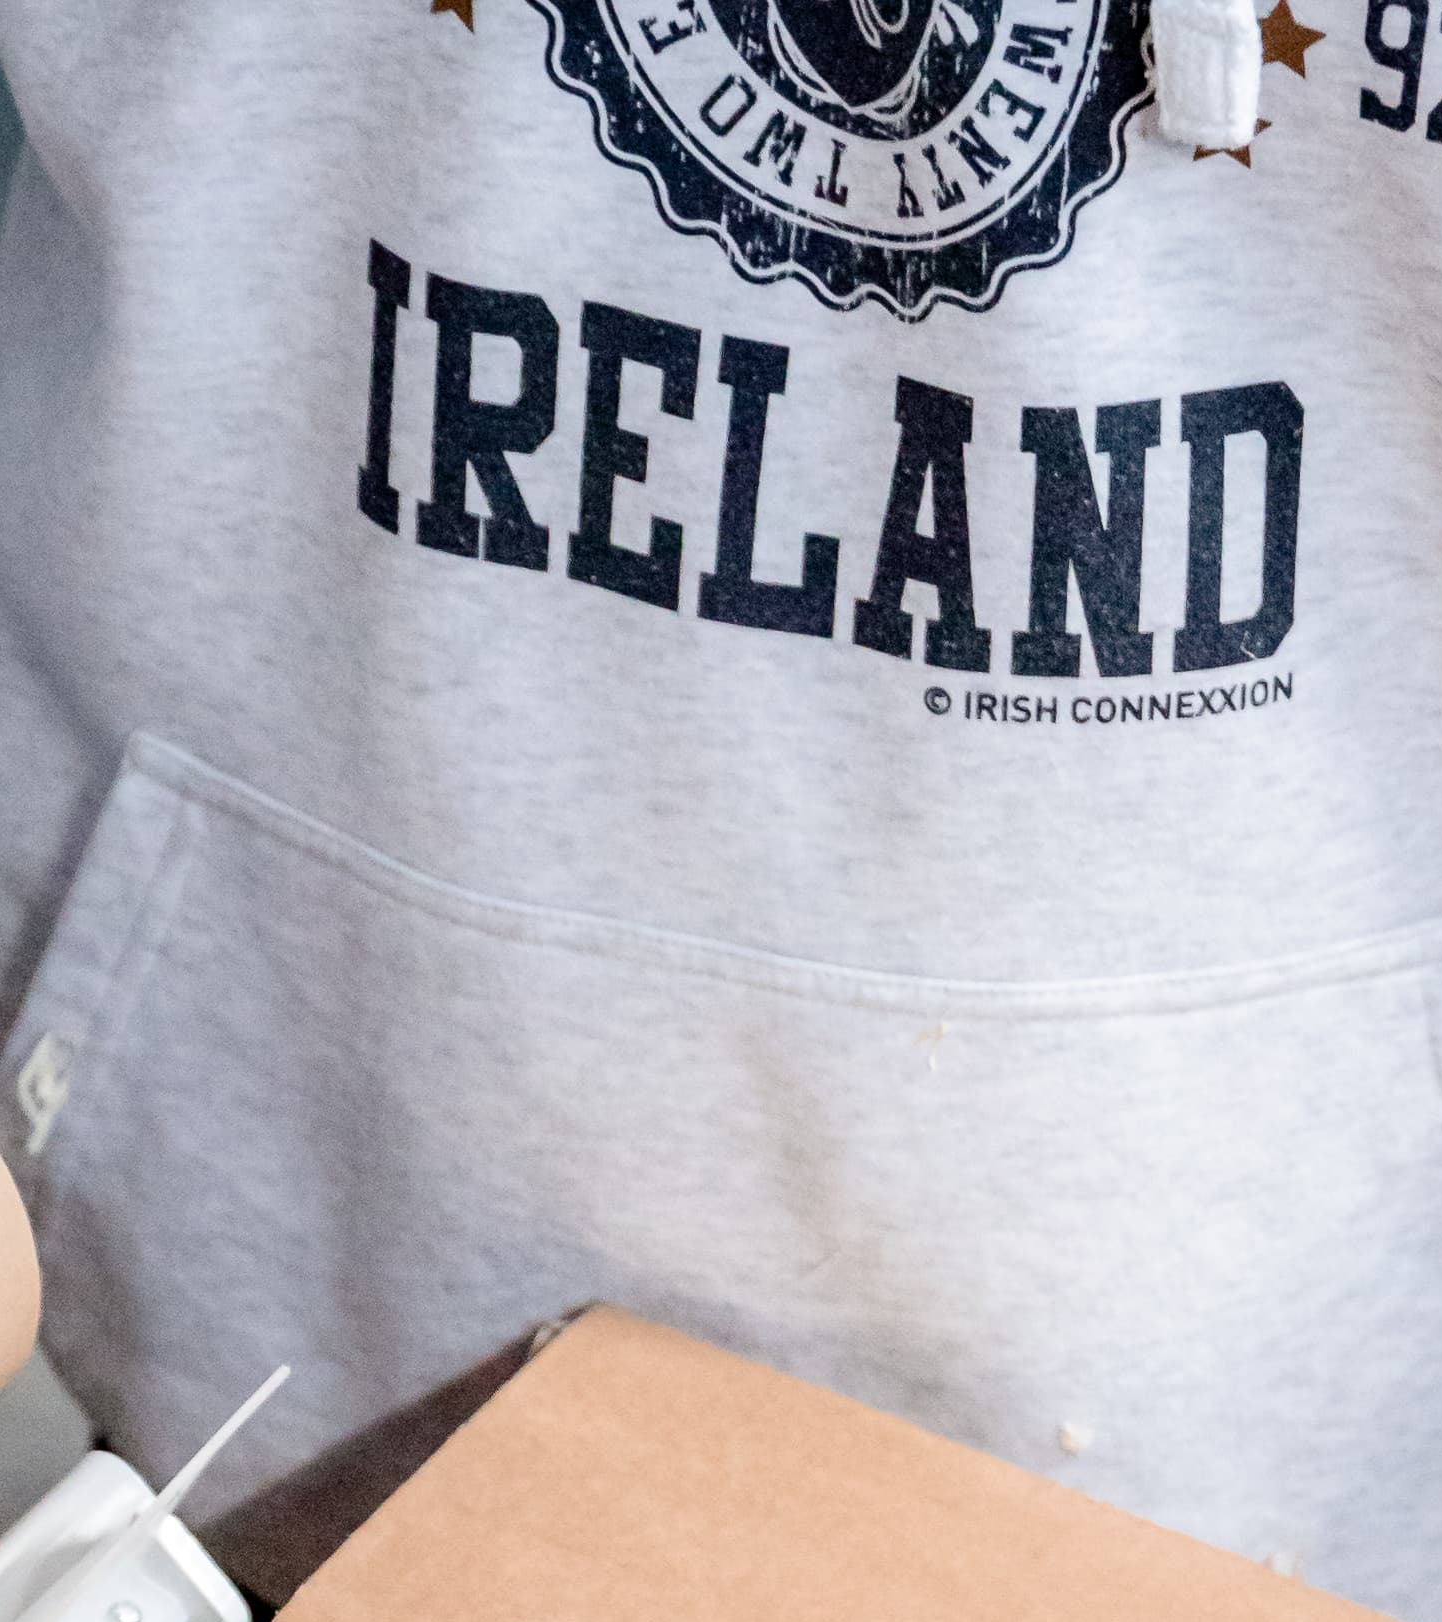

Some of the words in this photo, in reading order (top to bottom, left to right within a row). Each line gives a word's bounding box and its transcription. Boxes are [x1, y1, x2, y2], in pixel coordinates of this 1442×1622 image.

[700, 74, 849, 207] TWO
[894, 0, 1073, 218] WENTY
[357, 238, 1305, 678] IRELAND
[964, 690, 1058, 724] IRISH
[1070, 673, 1294, 724] CONNEXXION
